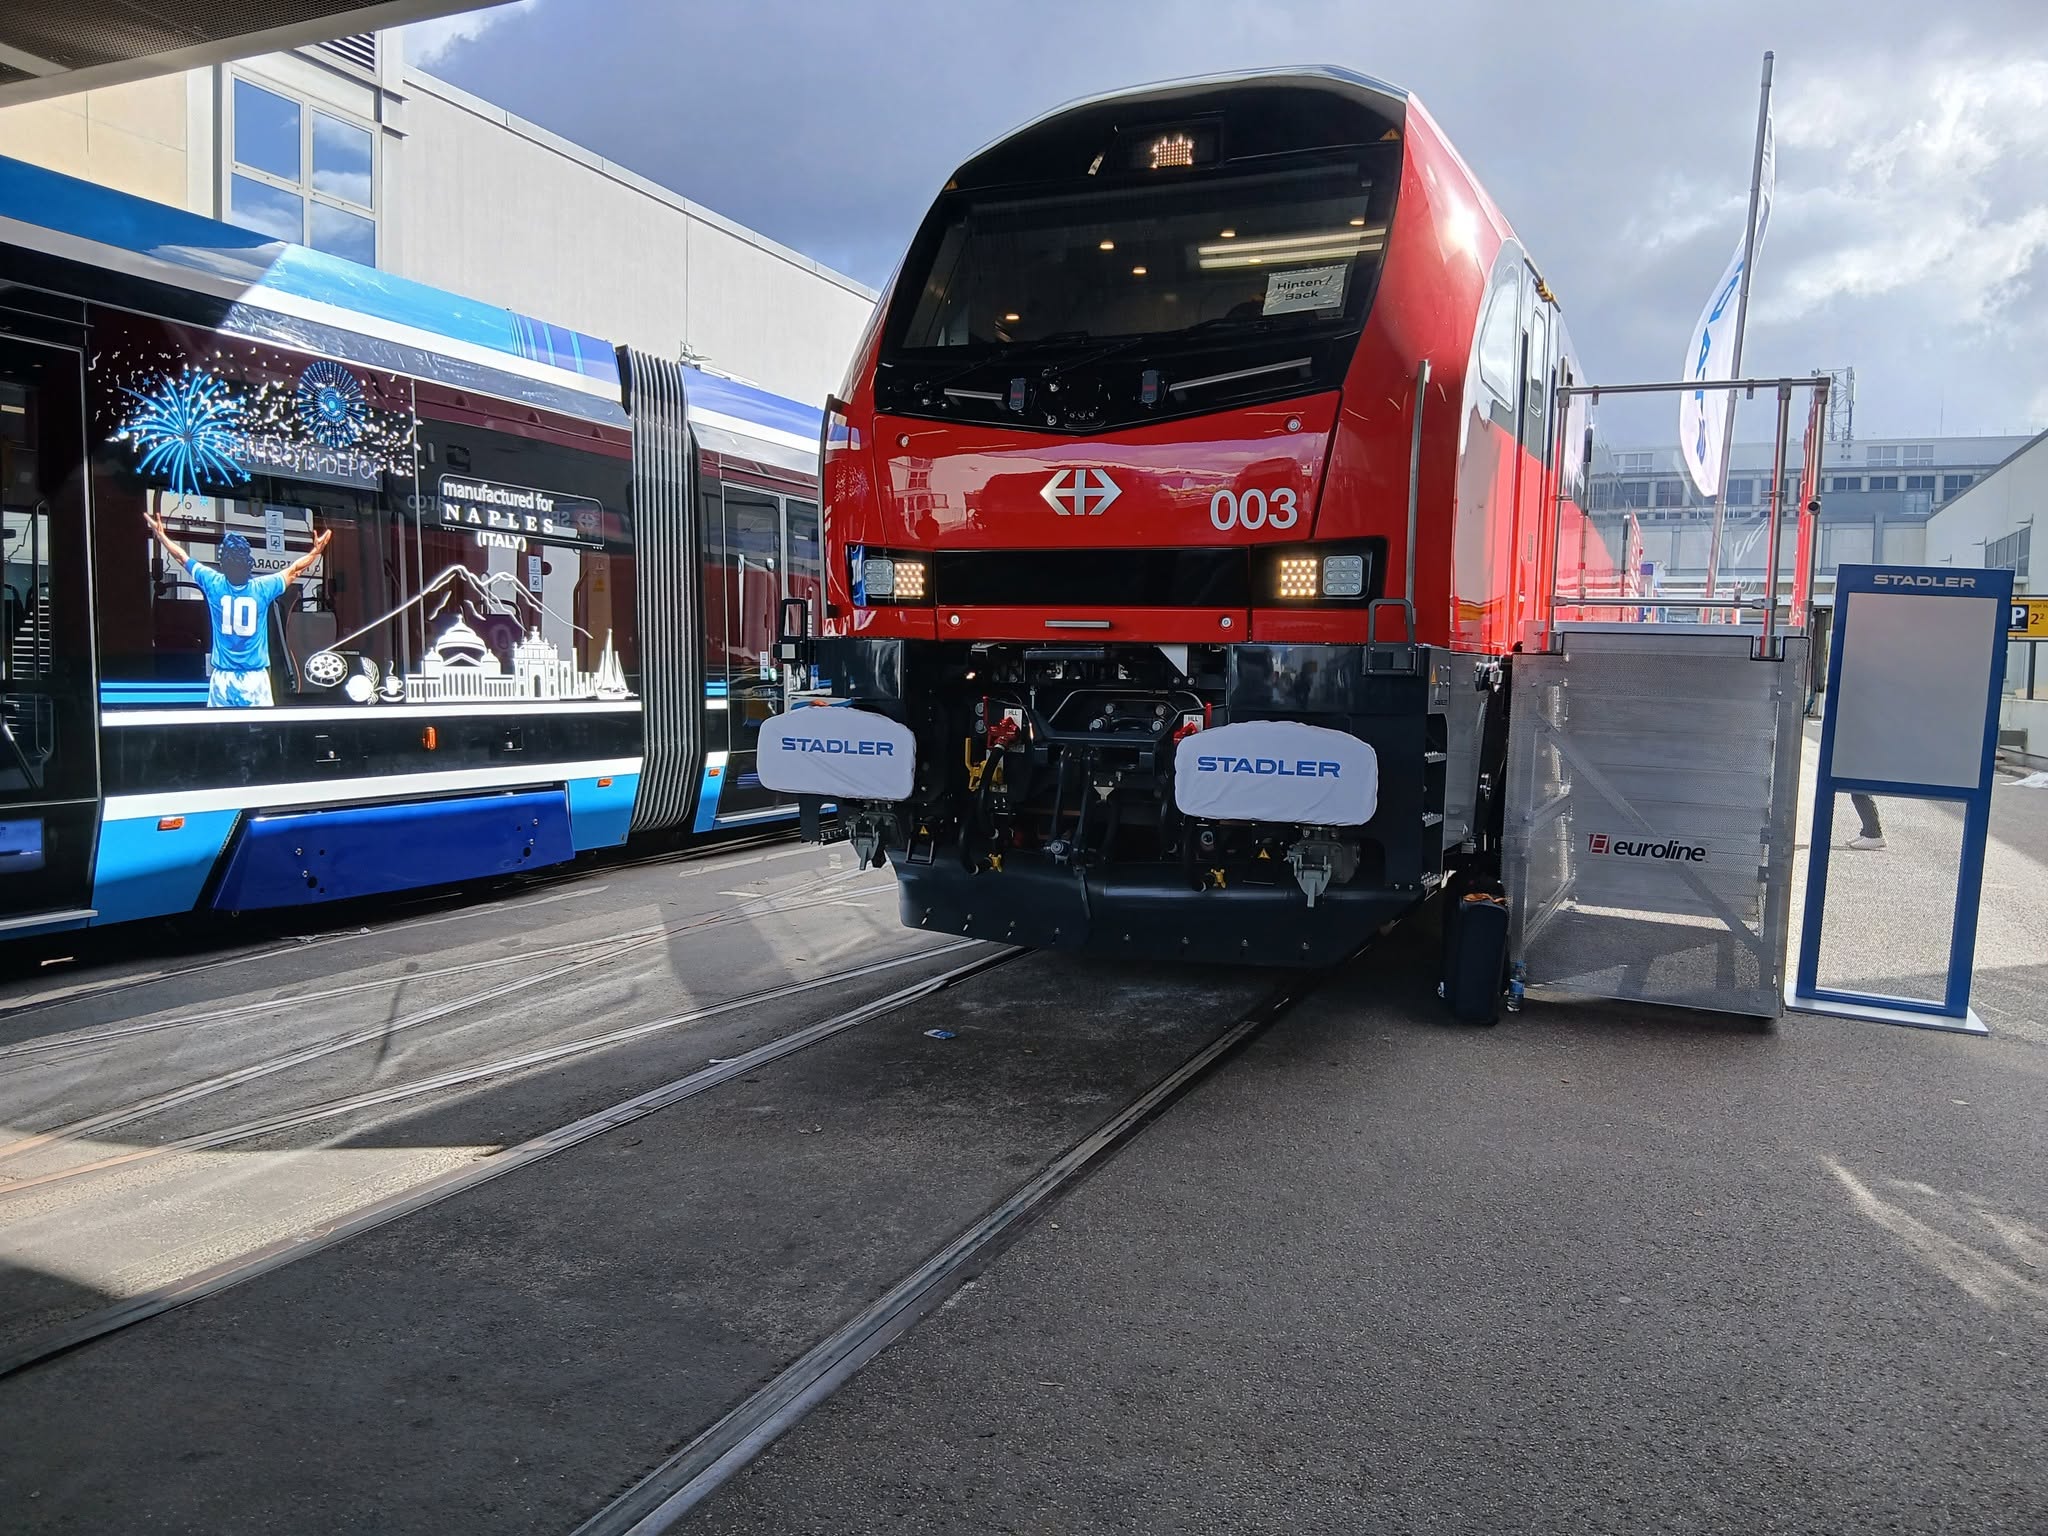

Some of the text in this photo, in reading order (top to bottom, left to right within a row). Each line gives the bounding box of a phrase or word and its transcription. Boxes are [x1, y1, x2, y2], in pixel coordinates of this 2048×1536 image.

[443, 481, 554, 512] manufactured for
[444, 502, 554, 534] NAPLES
[1210, 487, 1298, 531] 003
[477, 532, 527, 552] (ITALY)
[1873, 574, 1976, 588] STADLER
[220, 594, 257, 637] 10
[2011, 606, 2026, 625] P
[781, 737, 894, 756] STADLER
[1197, 756, 1341, 778] STADLER
[1613, 840, 1706, 861] euroline
